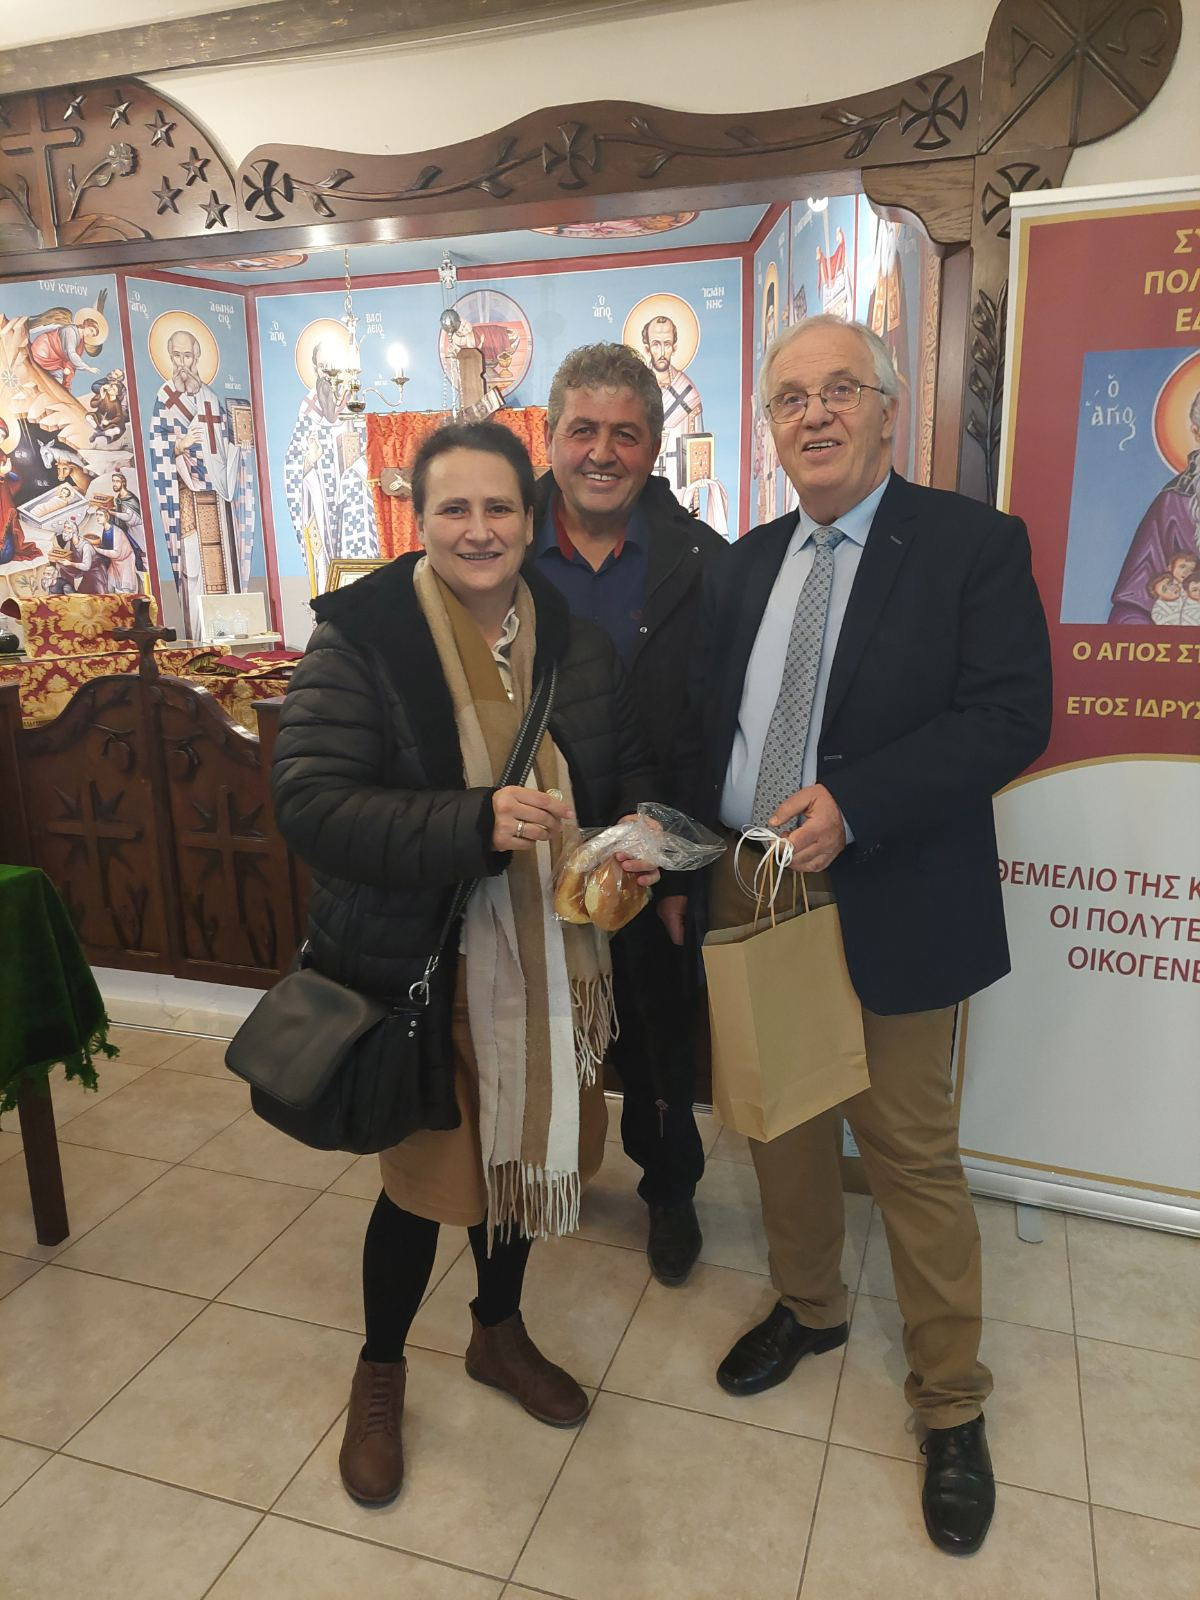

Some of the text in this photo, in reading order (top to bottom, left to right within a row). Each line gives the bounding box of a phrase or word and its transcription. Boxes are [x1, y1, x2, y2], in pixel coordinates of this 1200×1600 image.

[1174, 228, 1200, 254] Σ
[1072, 641, 1092, 661] Ο
[1096, 642, 1172, 663] ΑΓΙΟΣ
[1066, 696, 1130, 717] ΕΤΟΣ
[1124, 870, 1181, 900] ΤΗΣ
[1049, 904, 1200, 943] ΟΙ ΠΟΛΥΤΕ
[1067, 945, 1200, 984] ΟΙΚΟΓΕΝΕ
